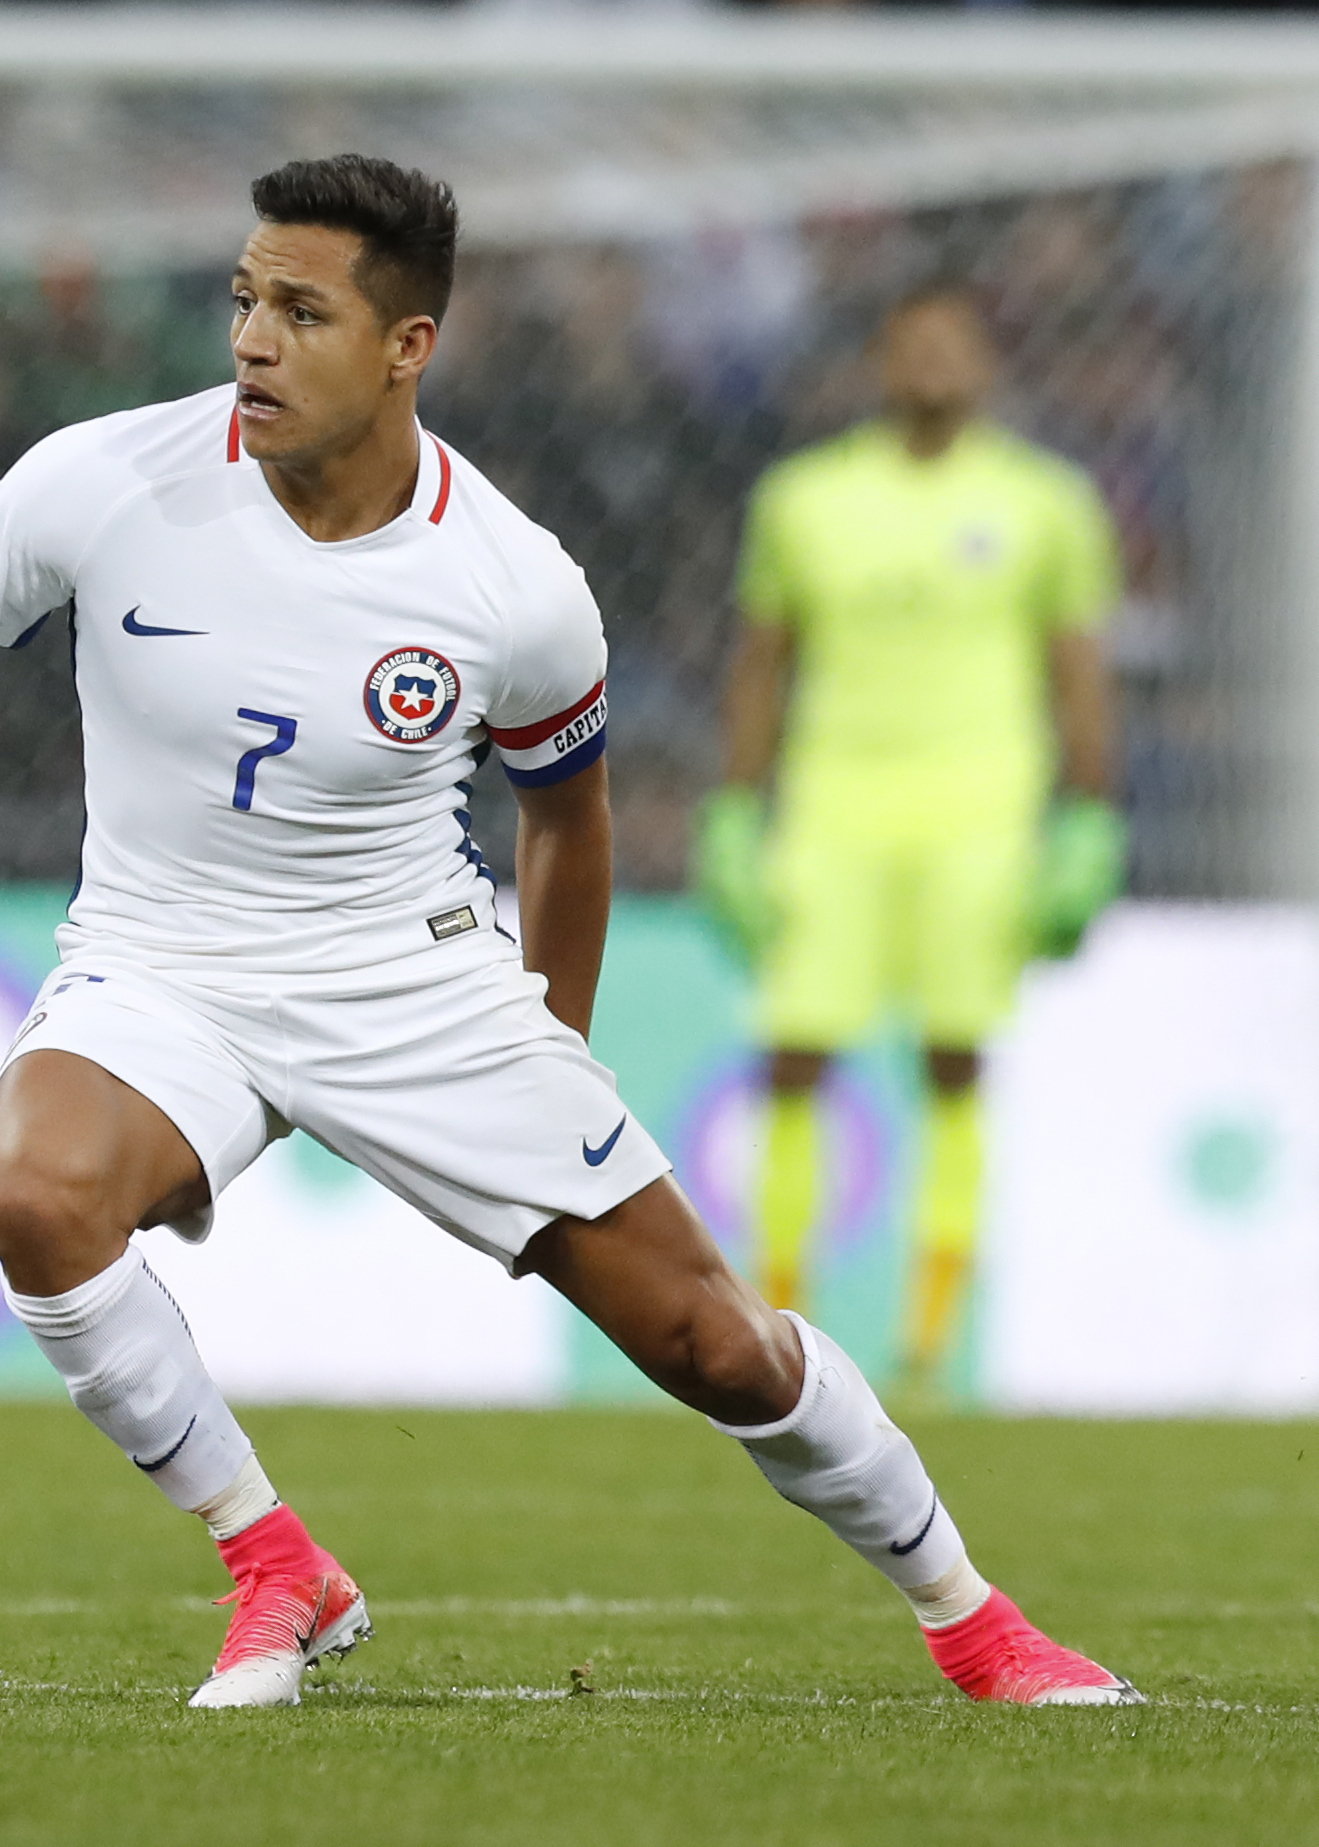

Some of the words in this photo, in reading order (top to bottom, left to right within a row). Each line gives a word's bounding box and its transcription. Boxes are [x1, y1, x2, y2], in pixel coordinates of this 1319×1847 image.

[370, 652, 420, 690] FEDERACION
[426, 656, 440, 668] DE
[439, 666, 457, 701] FUTBOL
[383, 721, 398, 735] DE
[401, 727, 427, 739] CHILE
[553, 692, 607, 753] CAPITA
[232, 707, 297, 811] 7
